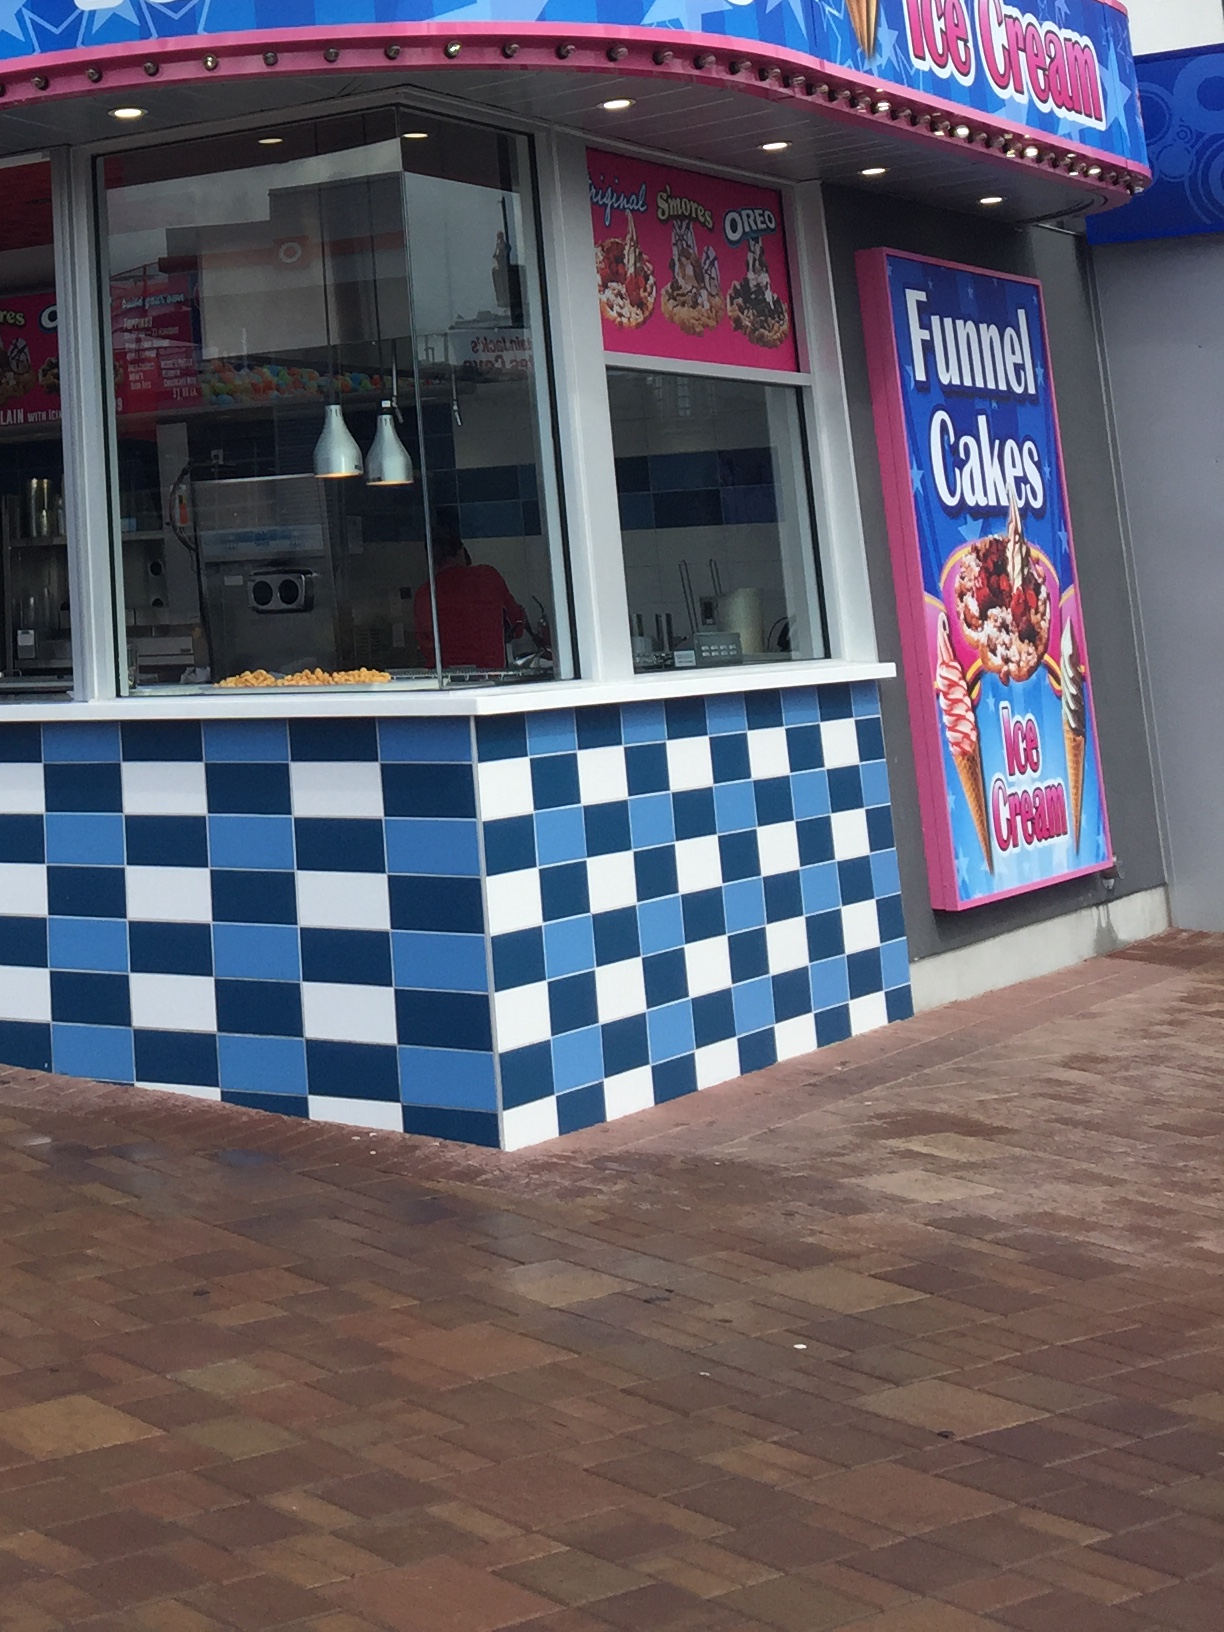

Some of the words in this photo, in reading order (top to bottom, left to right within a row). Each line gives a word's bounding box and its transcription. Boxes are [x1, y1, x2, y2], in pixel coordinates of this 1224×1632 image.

[589, 174, 648, 227] riginal
[656, 184, 715, 231] S'mores
[724, 209, 777, 244] OREO
[904, 287, 1037, 396] Funnel
[929, 409, 1045, 511] Cakes
[1001, 705, 1040, 777] Ice
[991, 777, 1069, 852] Cream
